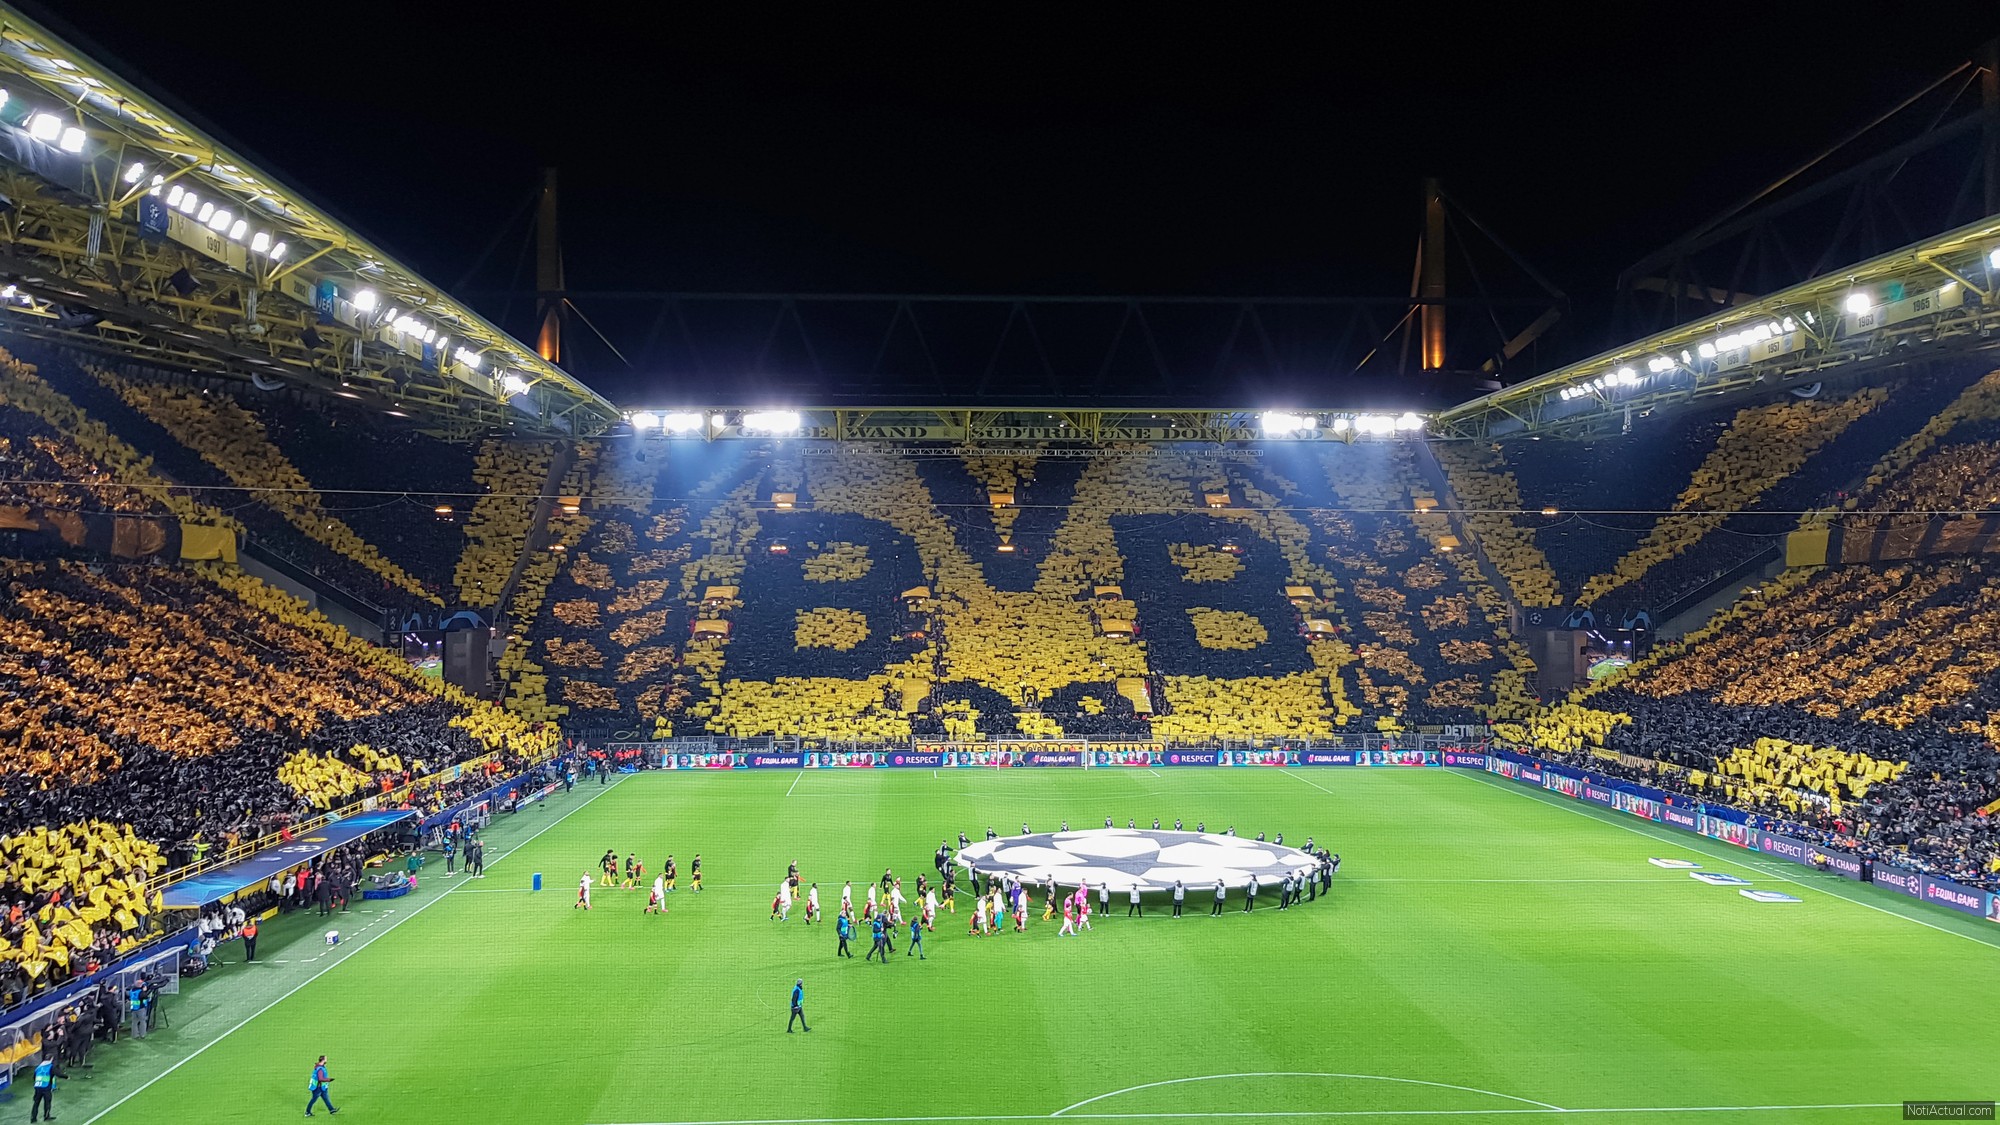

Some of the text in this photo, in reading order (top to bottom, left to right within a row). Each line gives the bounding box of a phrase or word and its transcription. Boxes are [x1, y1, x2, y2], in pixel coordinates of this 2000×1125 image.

[206, 235, 220, 254] 1997
[1913, 297, 1930, 312] 1965
[1858, 314, 1874, 328] 1963
[1767, 341, 1780, 354] 1957
[736, 426, 829, 438] GEBE
[846, 427, 927, 438] WAND
[971, 426, 1151, 439] SÜDTRIBÜNE
[905, 756, 939, 764] RESPECT
[1181, 755, 1214, 763] RESPECT
[1457, 757, 1484, 766] RESPECT
[1591, 787, 1610, 802] RESPECT
[1773, 841, 1802, 858] RESPECT
[1877, 870, 1906, 887] LEAGUE
